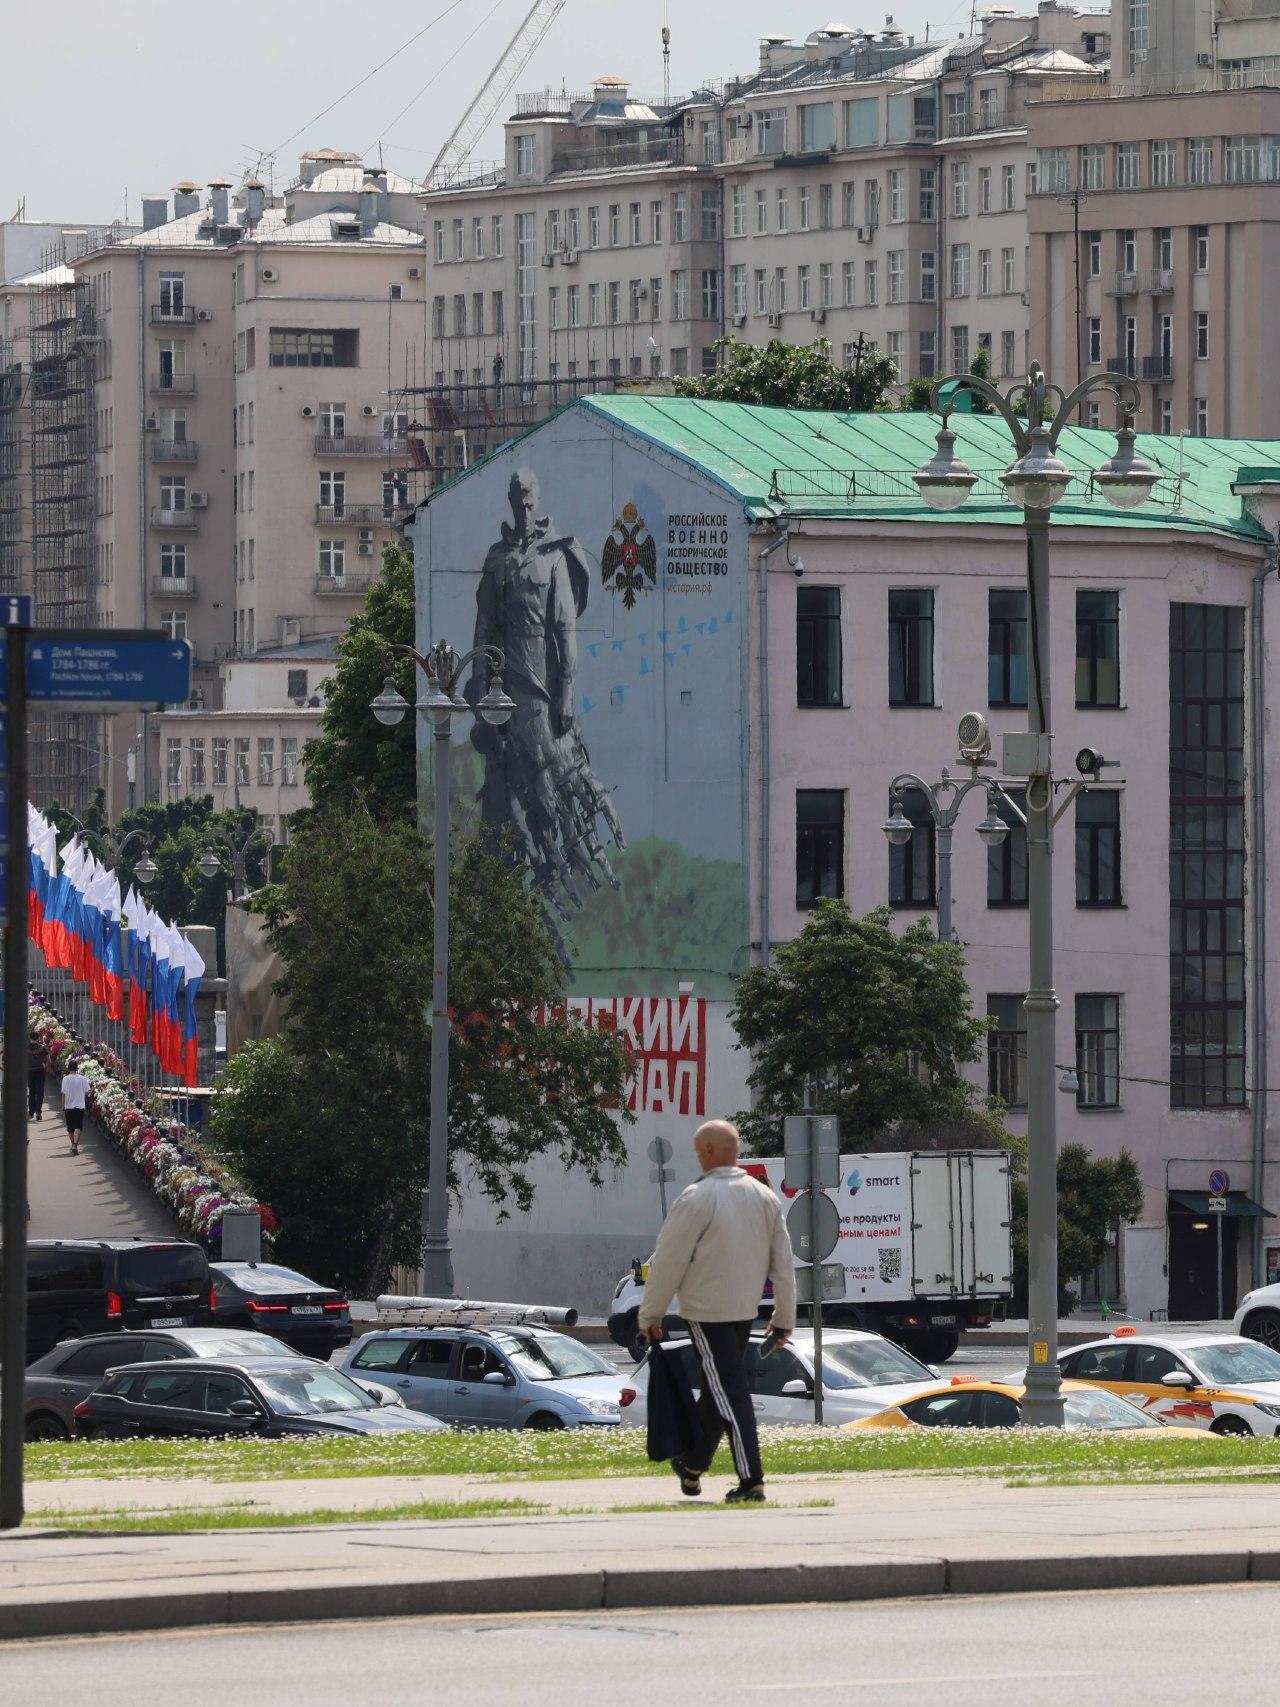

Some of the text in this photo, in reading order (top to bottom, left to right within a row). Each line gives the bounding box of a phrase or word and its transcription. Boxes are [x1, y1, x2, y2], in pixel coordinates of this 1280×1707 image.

[668, 513, 728, 527] РОССИЙСКОЕ
[668, 530, 728, 544] ВОЕННО
[667, 548, 728, 559] ИСТОРИЧЕСКОЕ
[667, 562, 728, 577] ОБЩЕСТВО
[667, 581, 713, 596] история.рф
[866, 1176, 900, 1187] smart
[853, 1213, 901, 1226] продукты
[837, 1227, 901, 1239] дным ценам!
